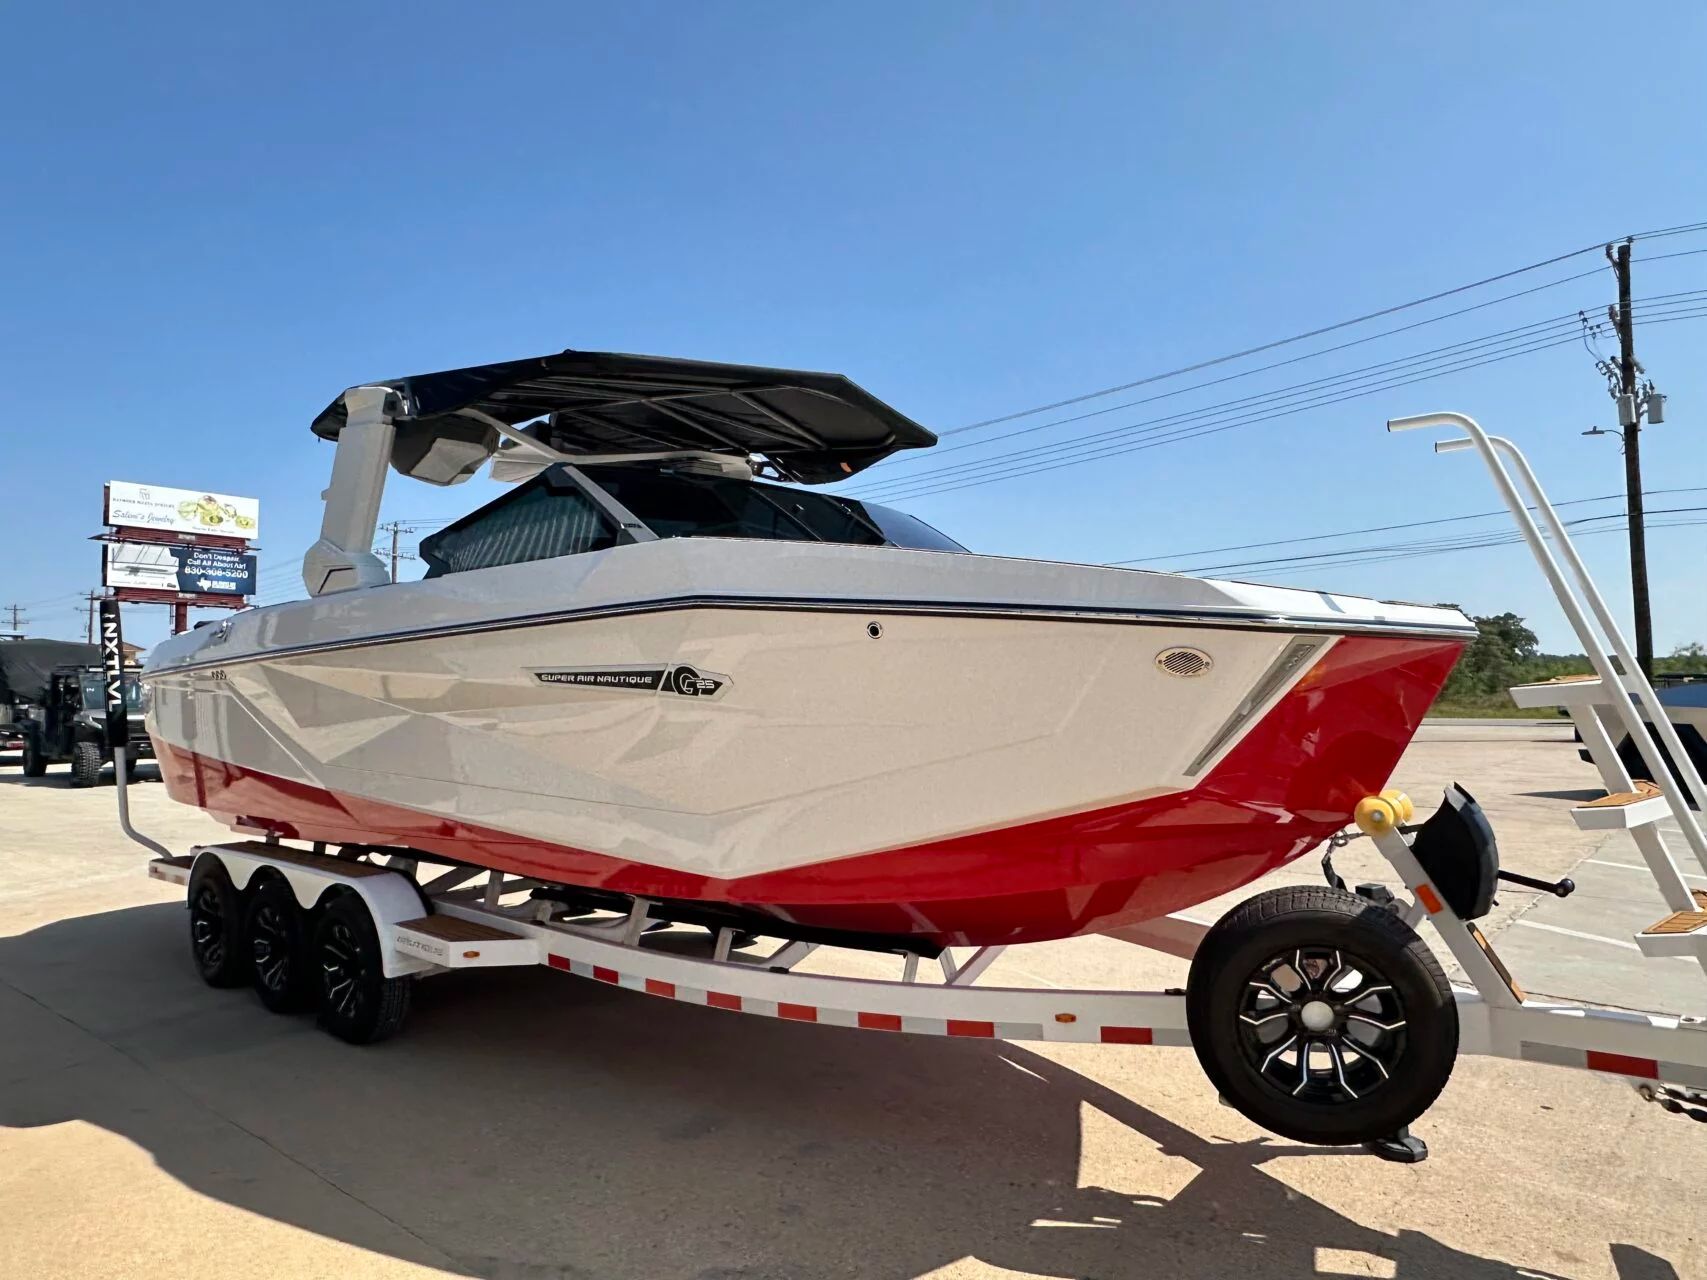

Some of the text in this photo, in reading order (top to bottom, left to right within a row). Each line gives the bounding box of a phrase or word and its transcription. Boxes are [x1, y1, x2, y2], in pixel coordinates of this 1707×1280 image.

[213, 560, 233, 568] About
[103, 622, 122, 712] NXTLVL
[541, 674, 575, 683] SUPER
[576, 675, 595, 683] AIR
[597, 676, 653, 684] NAUTIQUE
